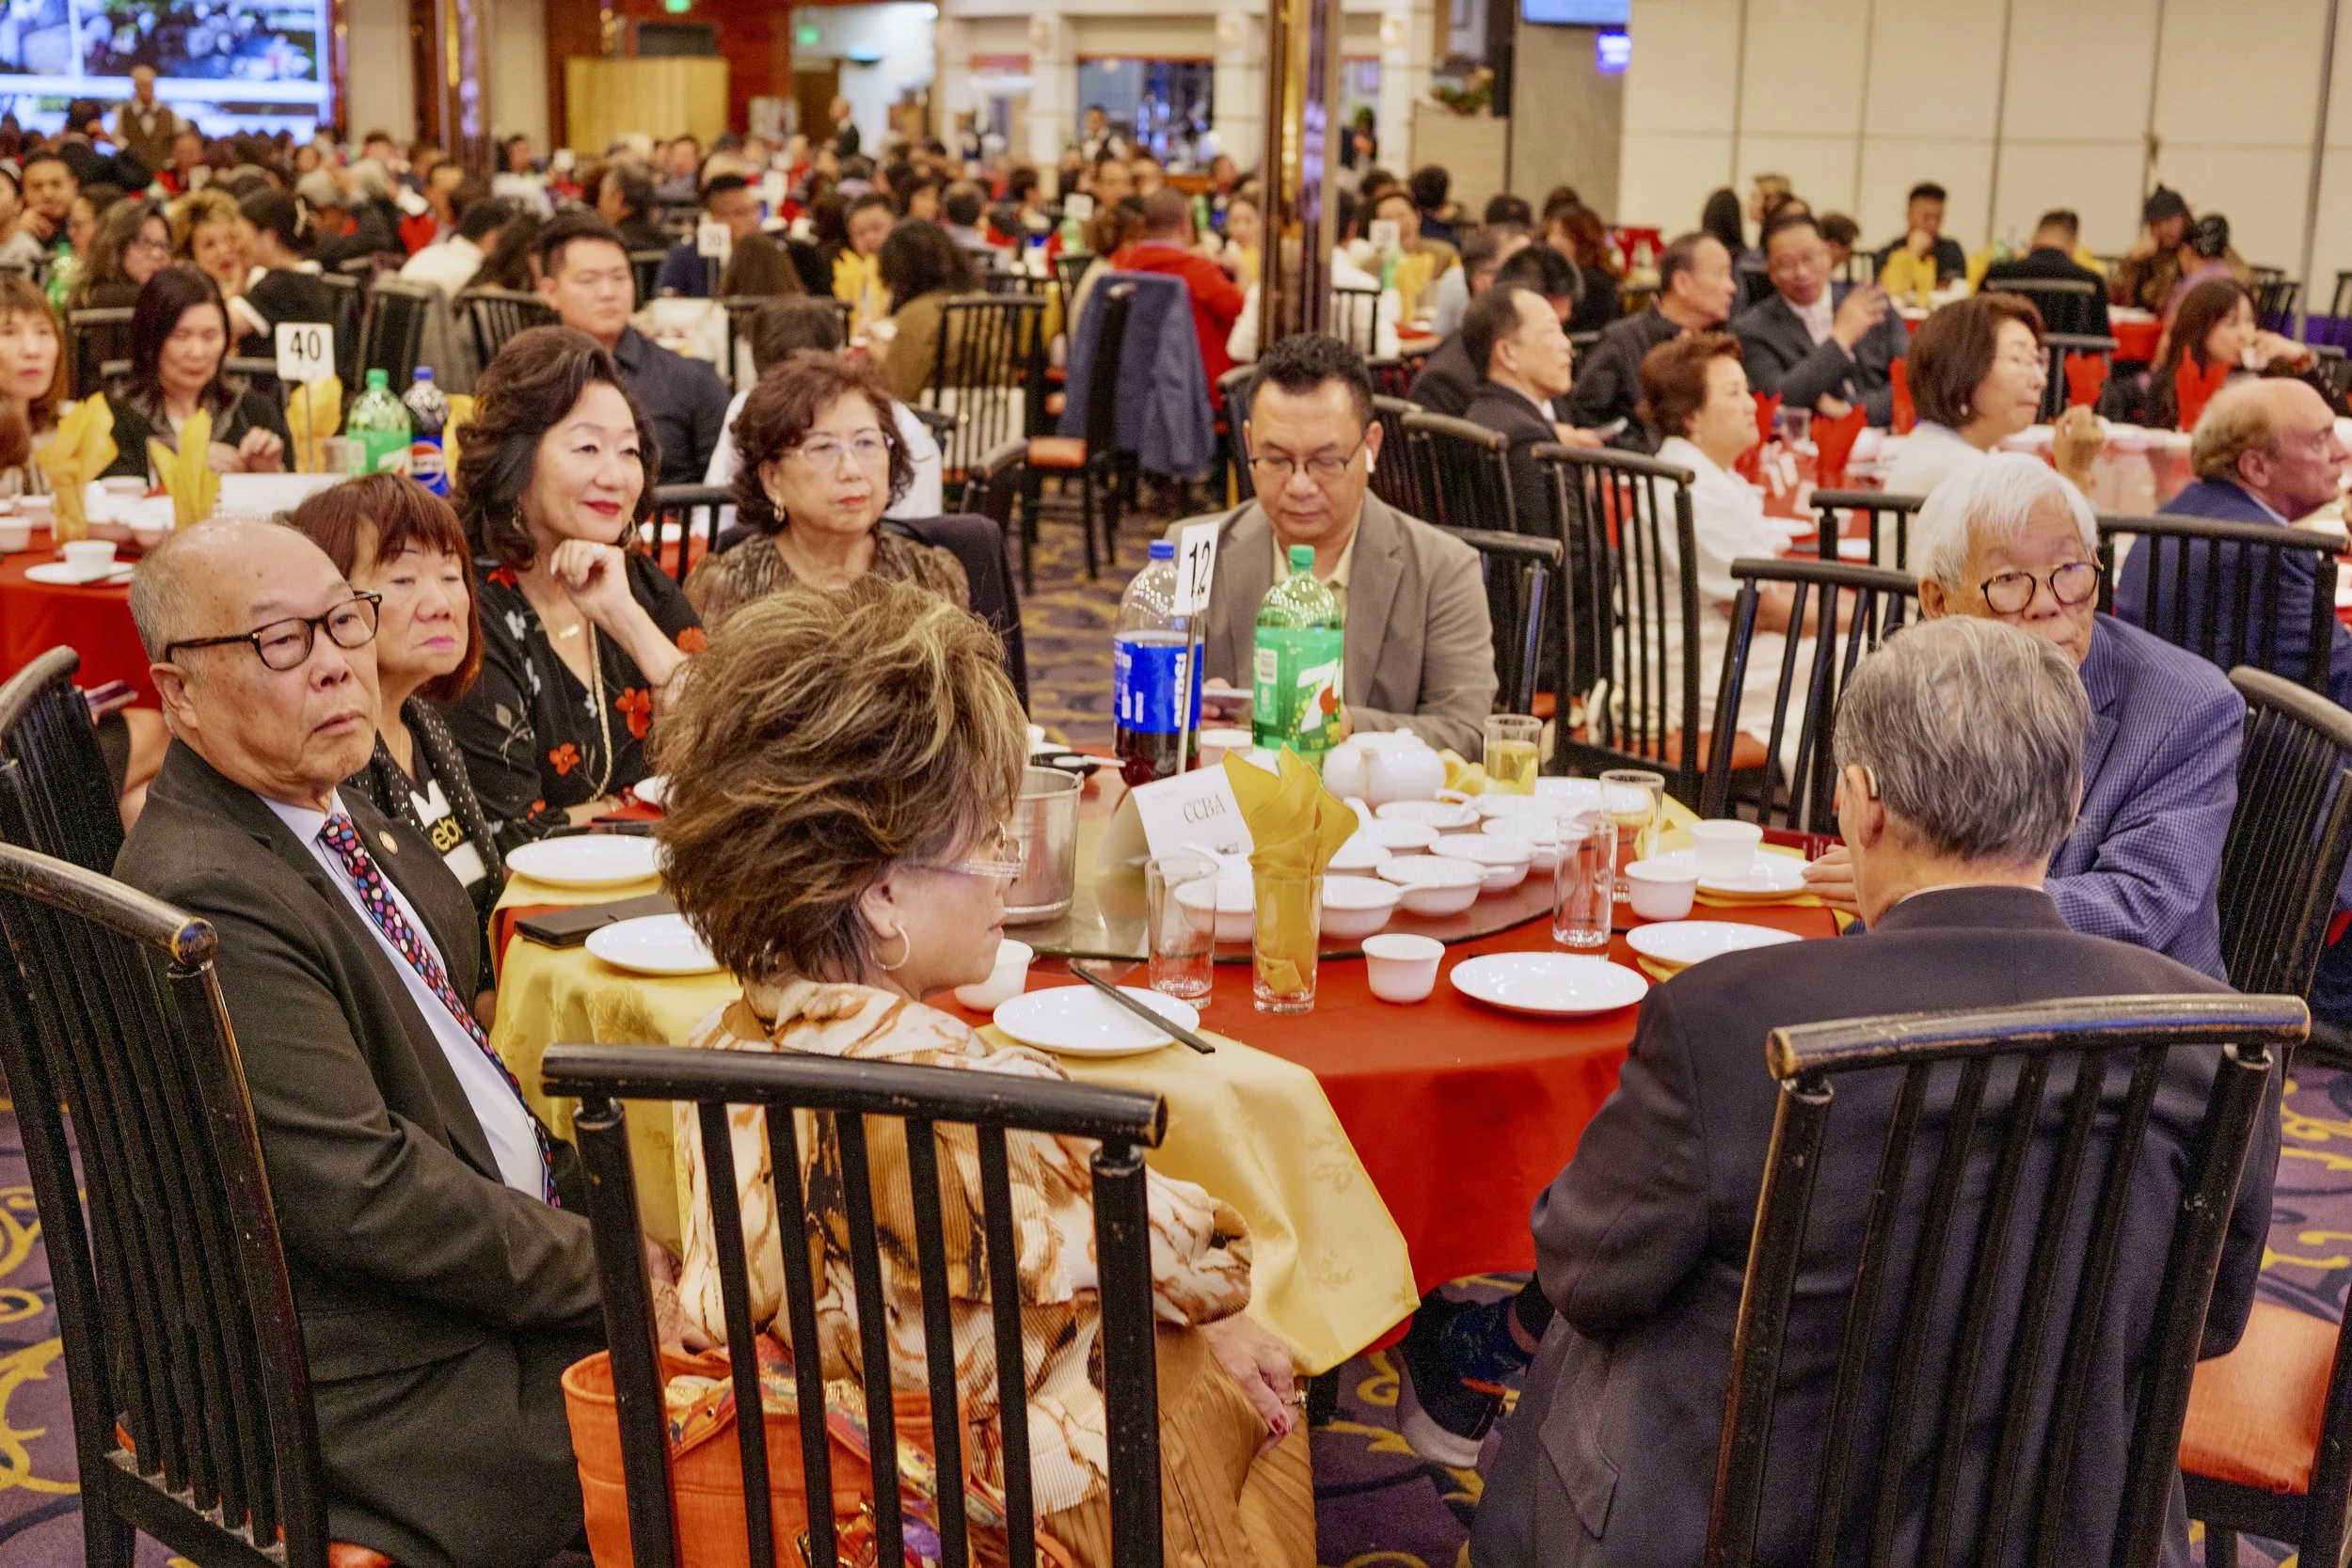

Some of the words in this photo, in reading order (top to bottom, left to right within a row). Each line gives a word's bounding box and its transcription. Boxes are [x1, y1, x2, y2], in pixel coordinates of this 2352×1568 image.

[290, 330, 321, 362] 40
[1188, 540, 1212, 598] 12
[1182, 792, 1227, 825] CCBA
